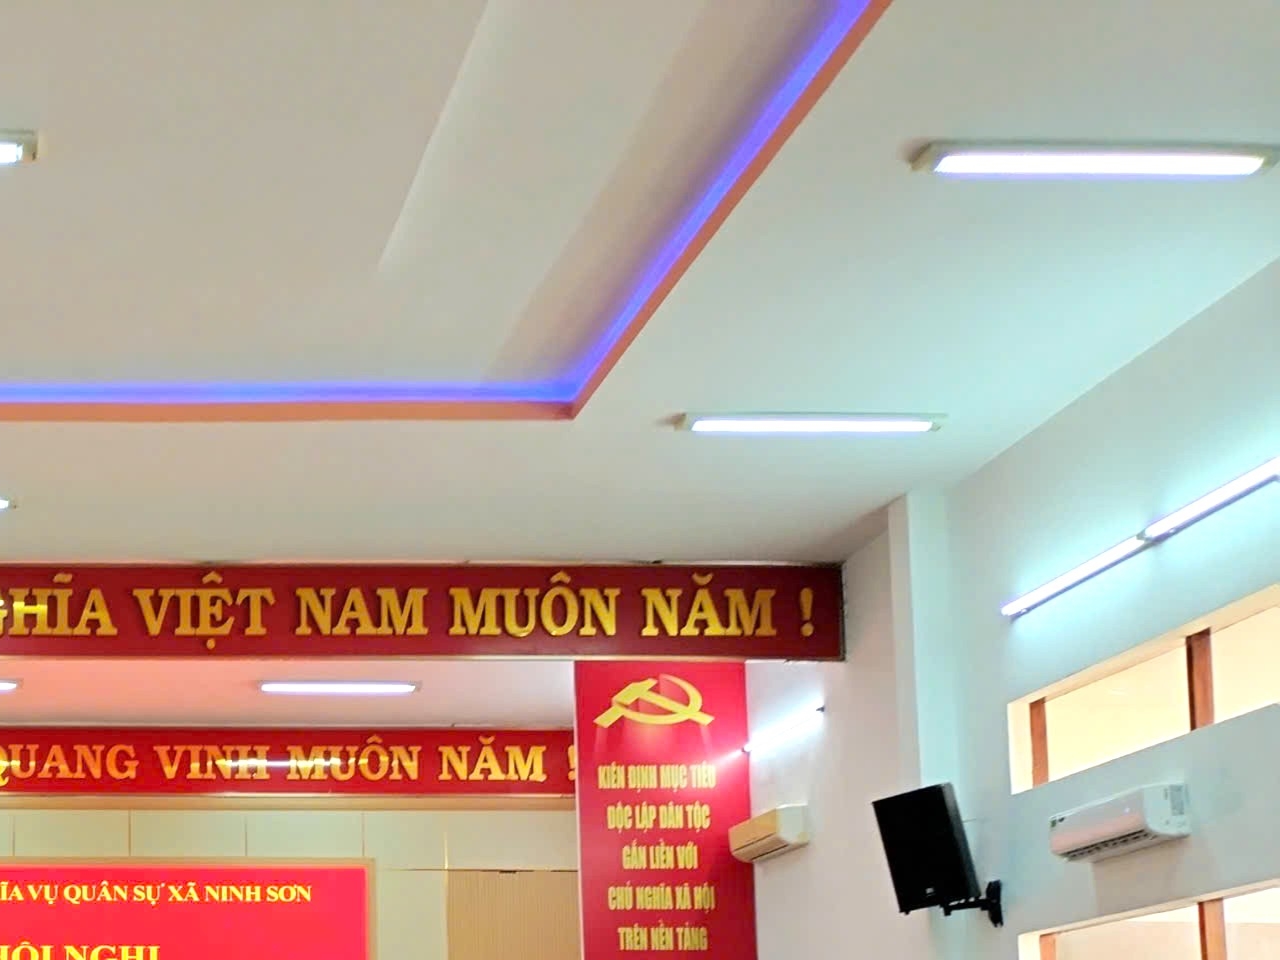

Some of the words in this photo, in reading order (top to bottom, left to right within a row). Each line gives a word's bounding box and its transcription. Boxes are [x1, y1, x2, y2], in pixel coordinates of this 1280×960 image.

[133, 573, 275, 649] VIỆT
[296, 589, 427, 634] NAM
[450, 573, 619, 637] MUÔN
[641, 573, 775, 637] NĂM
[155, 743, 273, 781] VINH
[286, 735, 421, 781] MUÔN
[439, 735, 547, 782] NĂM
[28, 885, 58, 904] VỤ
[64, 881, 127, 904] QUÂN
[133, 883, 164, 905] SỰ
[168, 882, 199, 901] XÃ
[205, 886, 261, 901] NINH
[266, 885, 311, 902] SƠN
